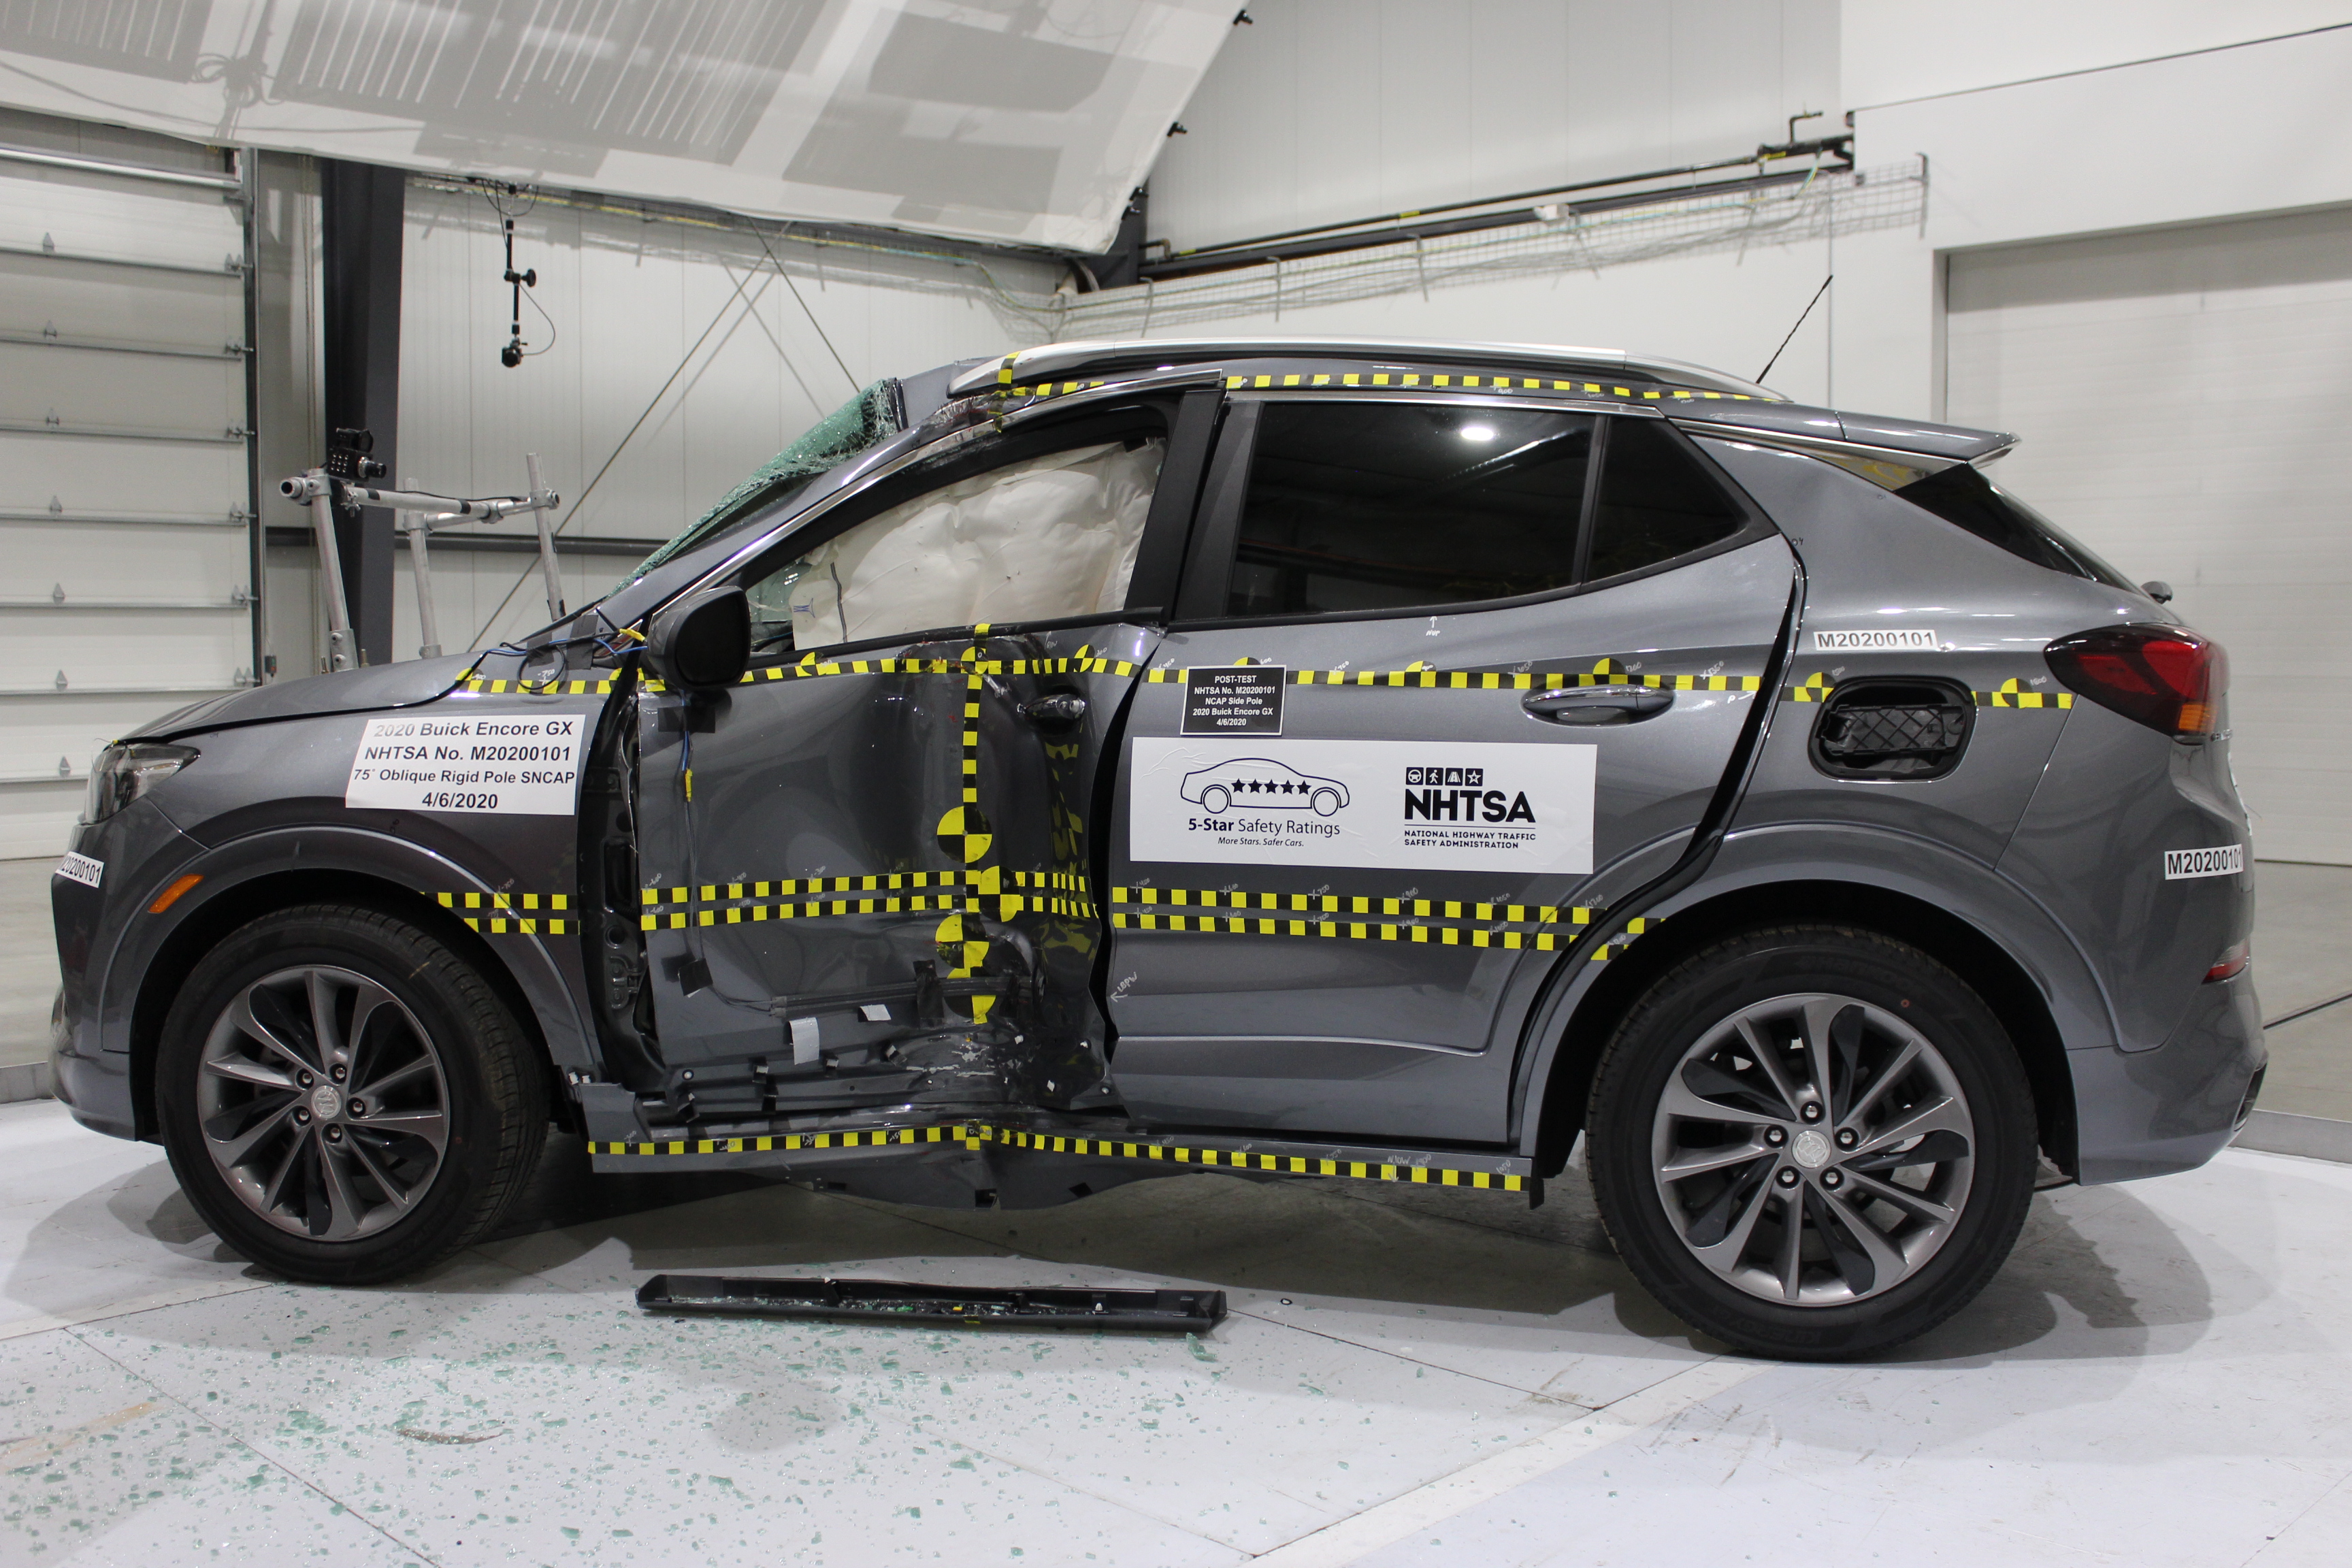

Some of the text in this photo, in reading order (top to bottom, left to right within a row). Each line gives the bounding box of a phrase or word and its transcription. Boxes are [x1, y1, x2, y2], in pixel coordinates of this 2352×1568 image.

[1818, 632, 1933, 647] M20200101
[1215, 675, 1257, 683] POST-TEST
[1194, 687, 1220, 695] NHTSA
[1235, 686, 1275, 694] M20200101
[1192, 708, 1210, 716] 2020
[1234, 707, 1260, 715] Encore
[1262, 707, 1273, 715] GX
[374, 721, 574, 737] 2020 Buick Encore GX
[1216, 718, 1247, 726] 4/6/2020
[364, 746, 571, 762] NHTSA No. M20200101
[379, 769, 436, 784] Oblique
[441, 770, 478, 785] Rigid
[484, 770, 516, 783] Pole
[521, 771, 575, 784] SNCAP
[422, 792, 498, 809] 4/6/2020
[1405, 789, 1536, 823] NHTSA
[1188, 817, 1341, 838] 5-Star Safety Ratings
[1405, 830, 1450, 838] NATIONAL
[1498, 832, 1536, 840] TRAFFIC
[1218, 837, 1305, 847] More Stars. Safer Cars.
[1439, 840, 1519, 849] ADMINISTRATION
[2168, 848, 2242, 875] M20200101
